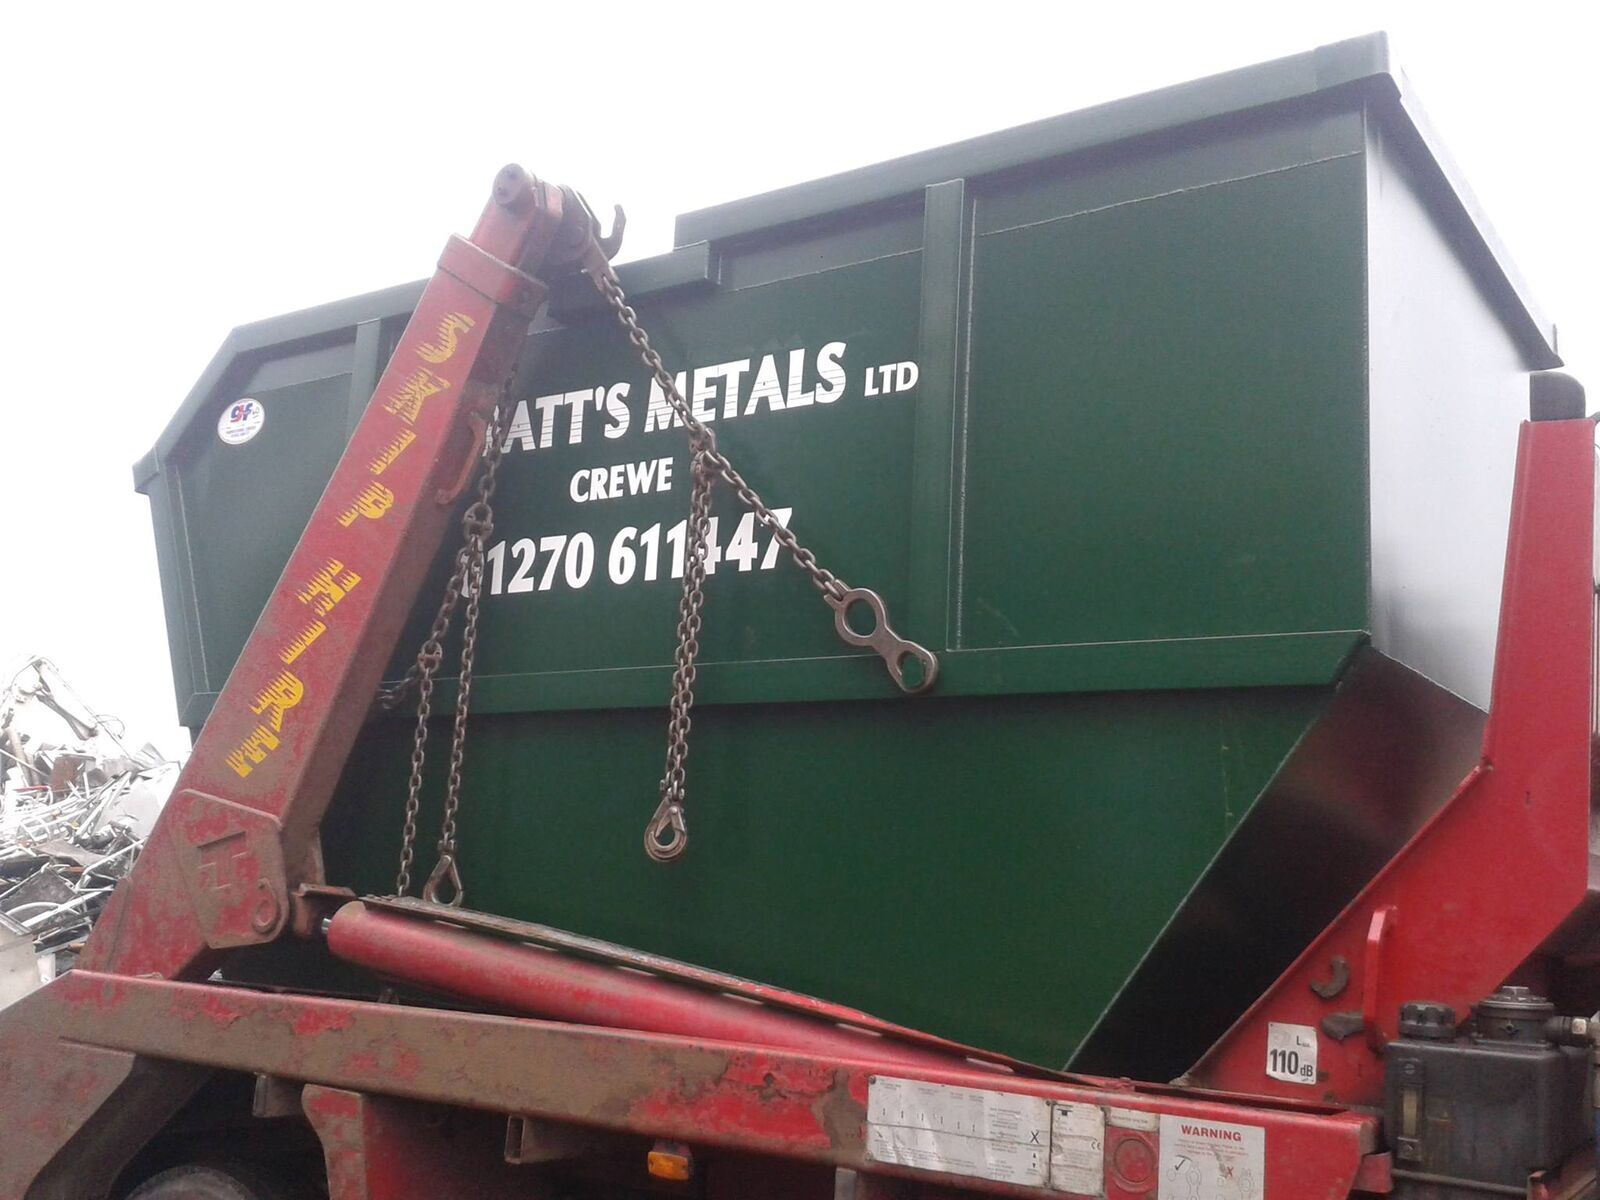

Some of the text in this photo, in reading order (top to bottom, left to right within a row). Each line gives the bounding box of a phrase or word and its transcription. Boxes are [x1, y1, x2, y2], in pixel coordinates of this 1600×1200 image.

[644, 342, 847, 434] METALS
[863, 361, 919, 397] LTD
[569, 456, 674, 503] CREWE
[226, 312, 476, 778] SKIP HIRE
[460, 531, 595, 598] 1270
[1270, 1049, 1313, 1077] 110 dB
[1181, 1124, 1242, 1142] WARNING
